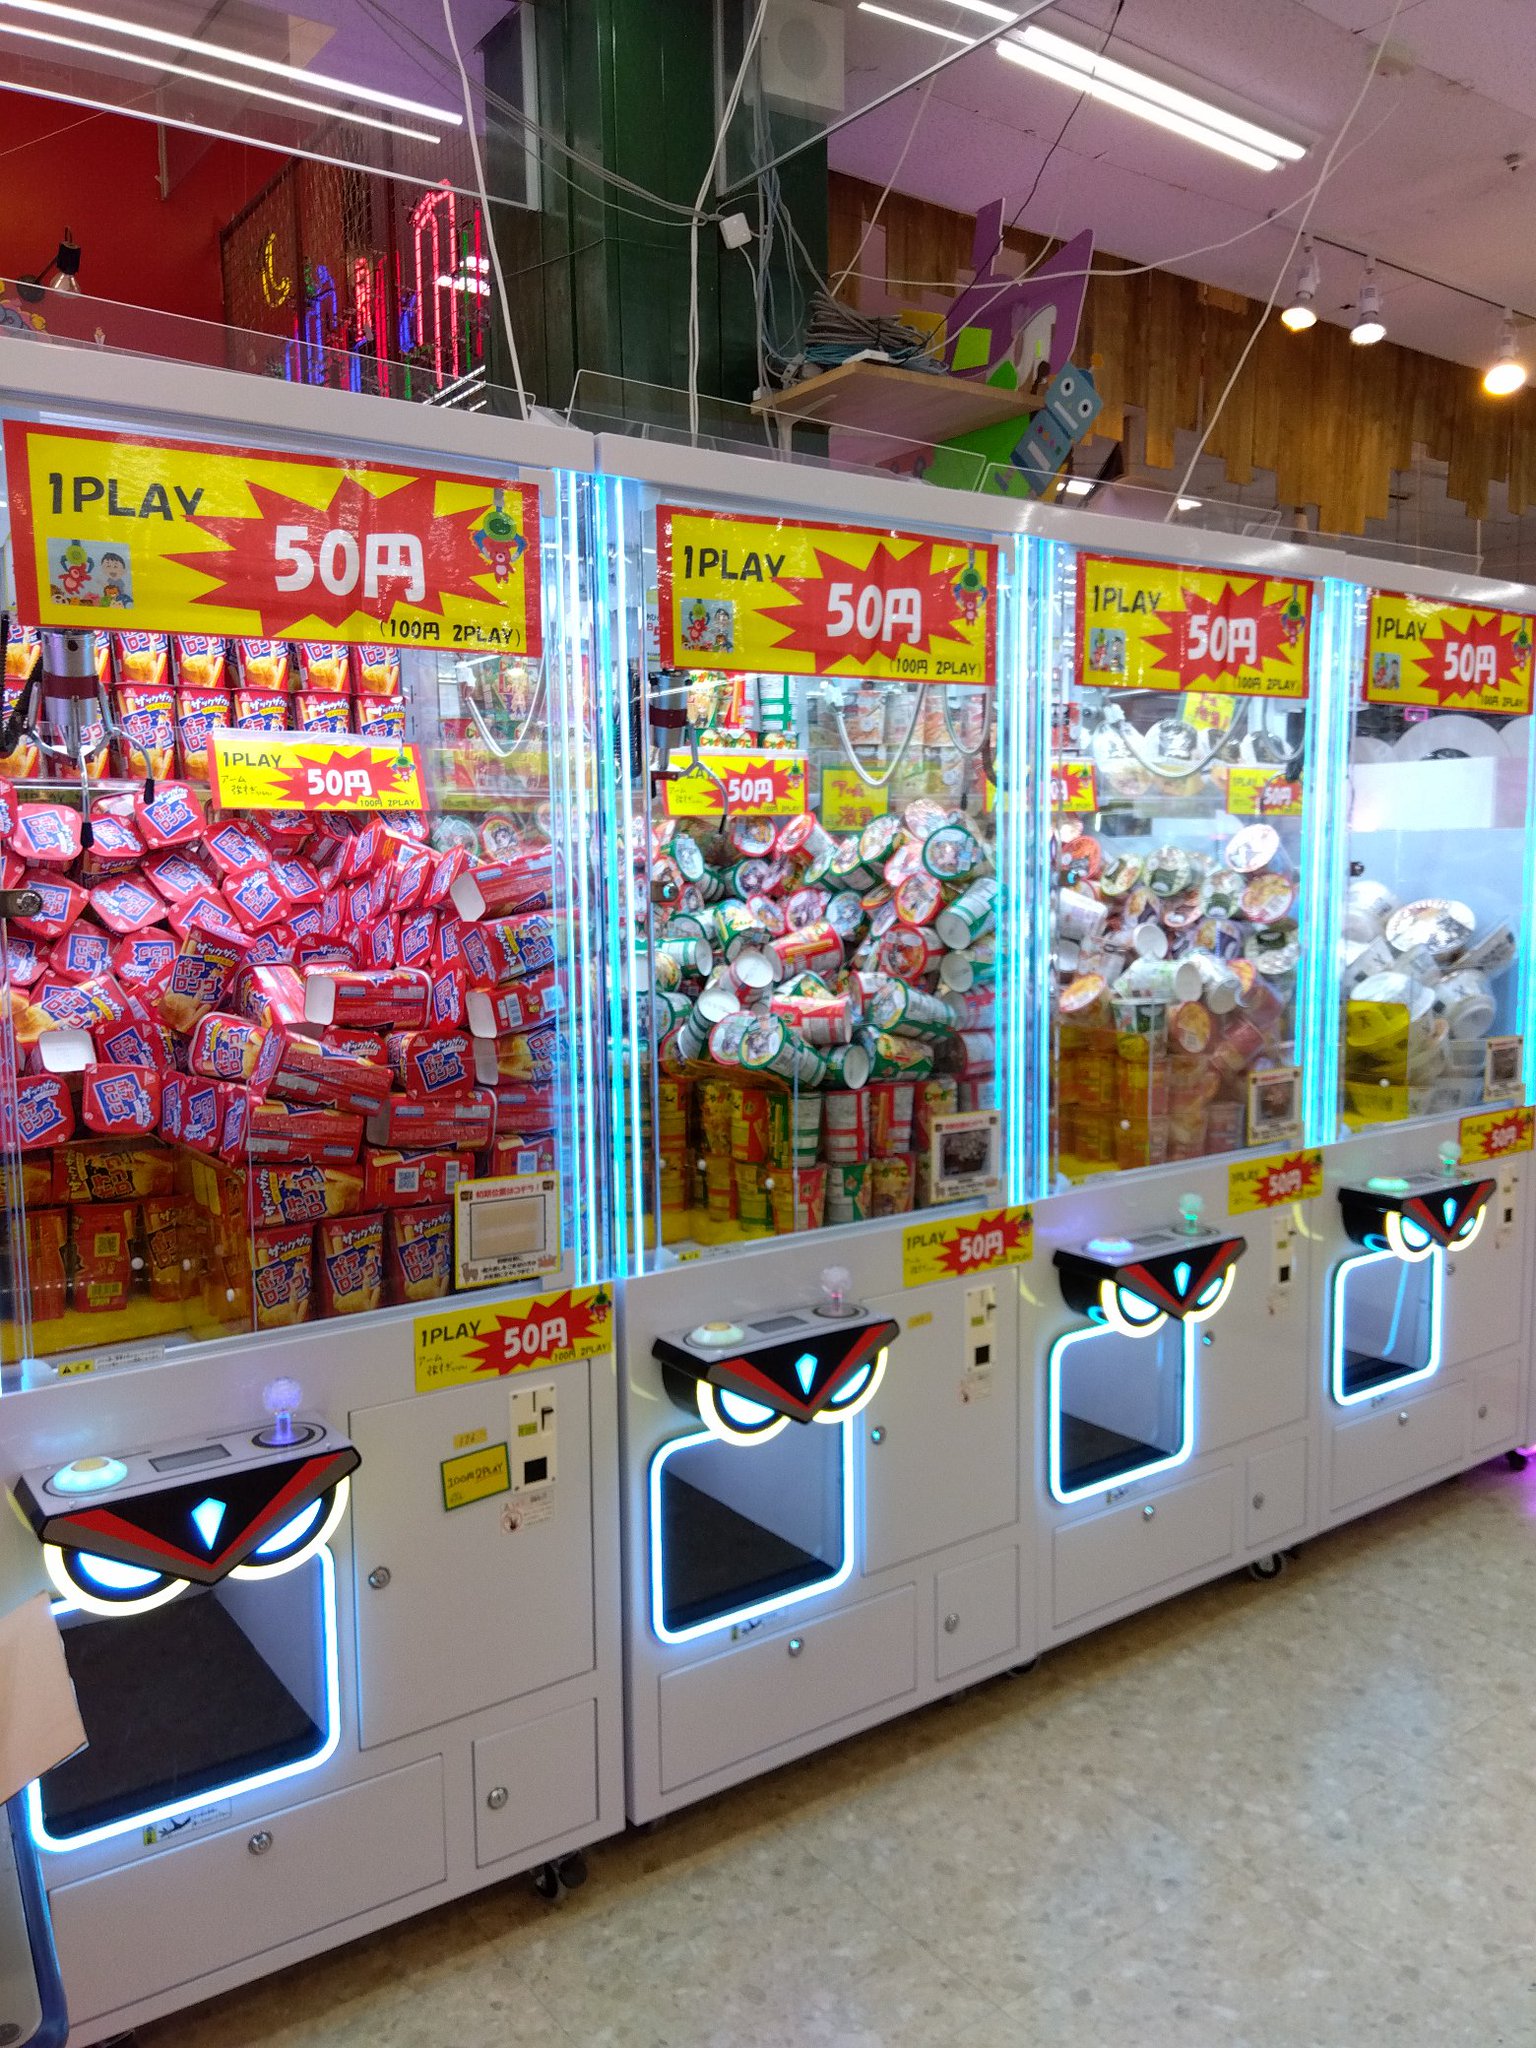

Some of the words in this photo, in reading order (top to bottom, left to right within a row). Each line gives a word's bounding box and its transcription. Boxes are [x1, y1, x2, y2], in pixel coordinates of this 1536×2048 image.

[49, 473, 204, 522] 1PLAY
[274, 526, 427, 602] 50円
[683, 545, 785, 582] 1PLAY
[826, 582, 921, 644] 50円
[1093, 585, 1162, 615] 1PLAY
[381, 620, 441, 642] (100円
[453, 624, 521, 647] 2PLAY)
[1188, 614, 1258, 665] 50円
[1376, 616, 1427, 641] 1PLAY
[890, 657, 928, 674] (100円
[935, 660, 982, 678] 2PLAY)
[1444, 641, 1496, 685] 50円
[223, 752, 282, 769] 1PLAY
[307, 769, 372, 797] 50円
[727, 778, 774, 803] 50円
[175, 958, 205, 978] ポテ
[60, 988, 87, 1010] ポテ
[403, 1242, 430, 1265] ポテ
[906, 1230, 948, 1251] 1PLAY
[960, 1230, 1004, 1263] 50円
[257, 1264, 286, 1291] ポテ
[332, 1251, 361, 1277] ポテ
[421, 1320, 482, 1347] 1PLAY
[504, 1318, 568, 1359] 50円
